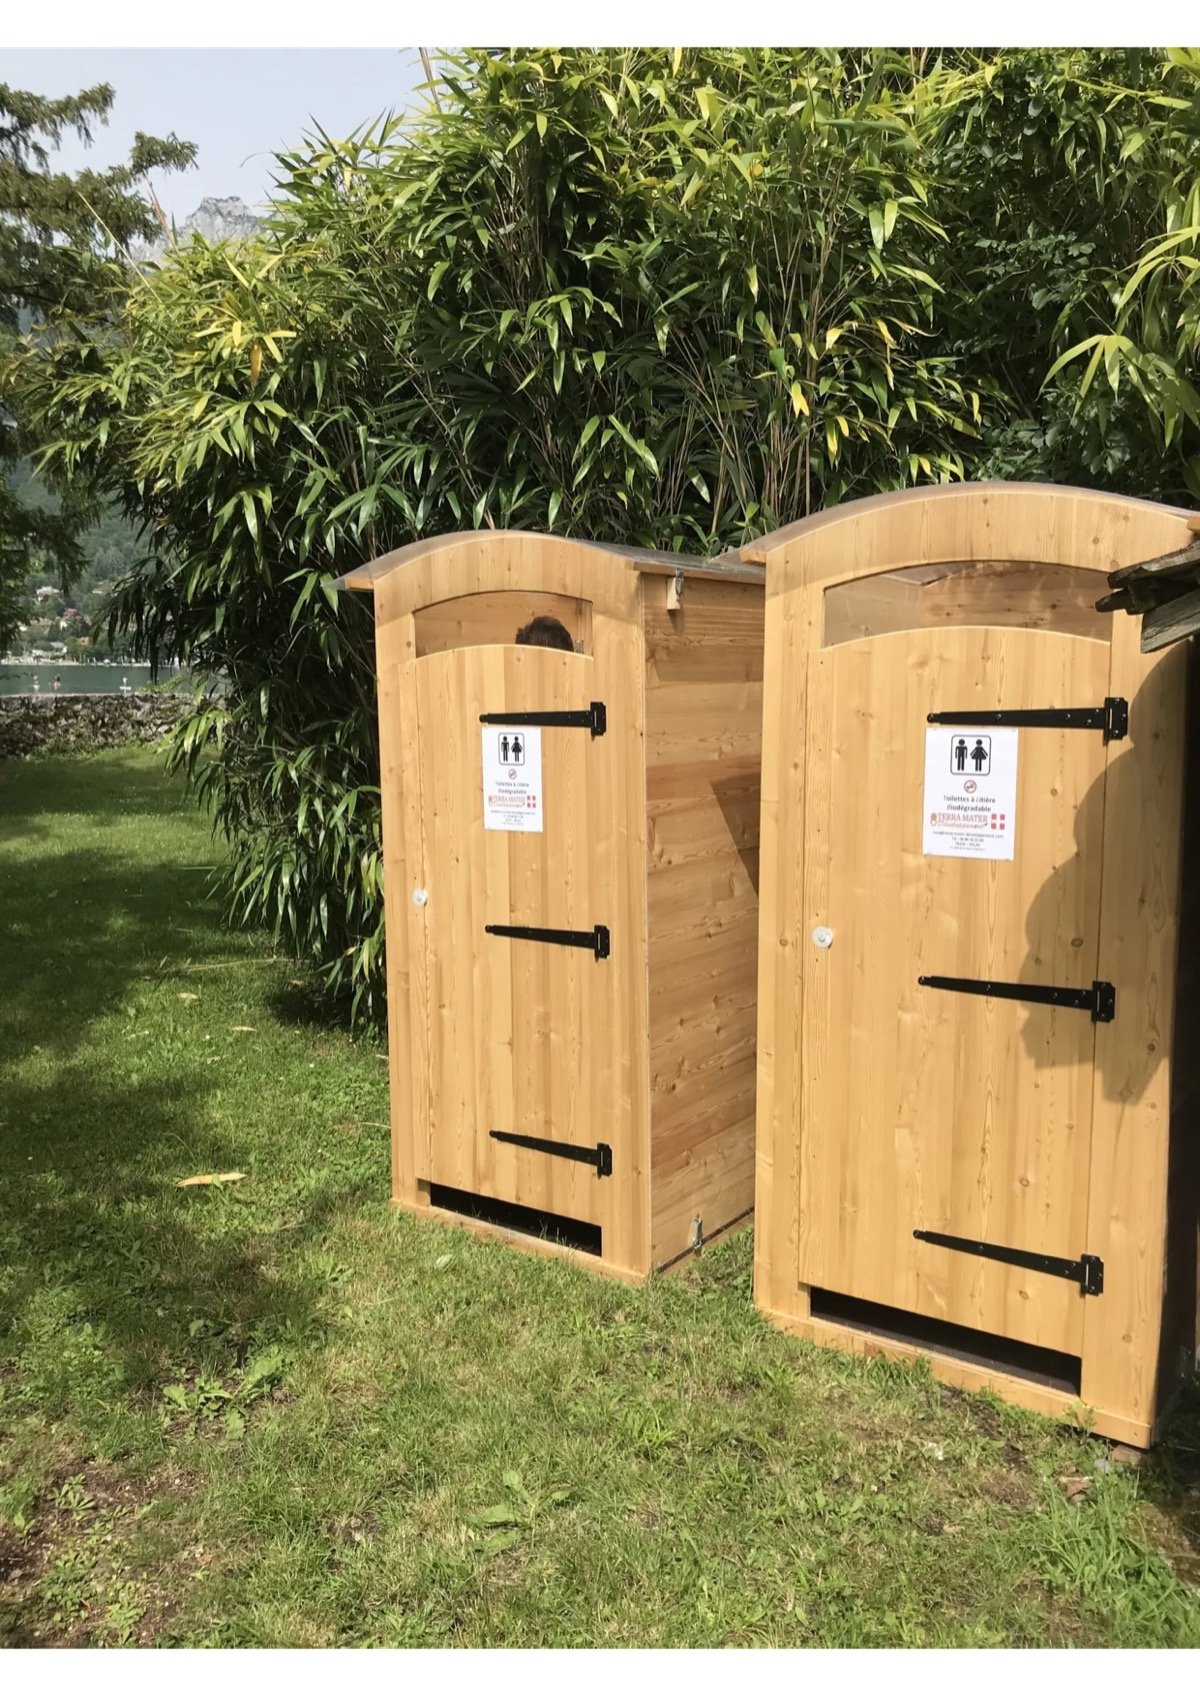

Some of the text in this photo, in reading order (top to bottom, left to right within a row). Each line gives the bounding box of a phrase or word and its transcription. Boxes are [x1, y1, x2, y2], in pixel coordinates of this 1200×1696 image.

[946, 804, 991, 812] Biodégradable
[937, 813, 988, 823] TERRA MATER
